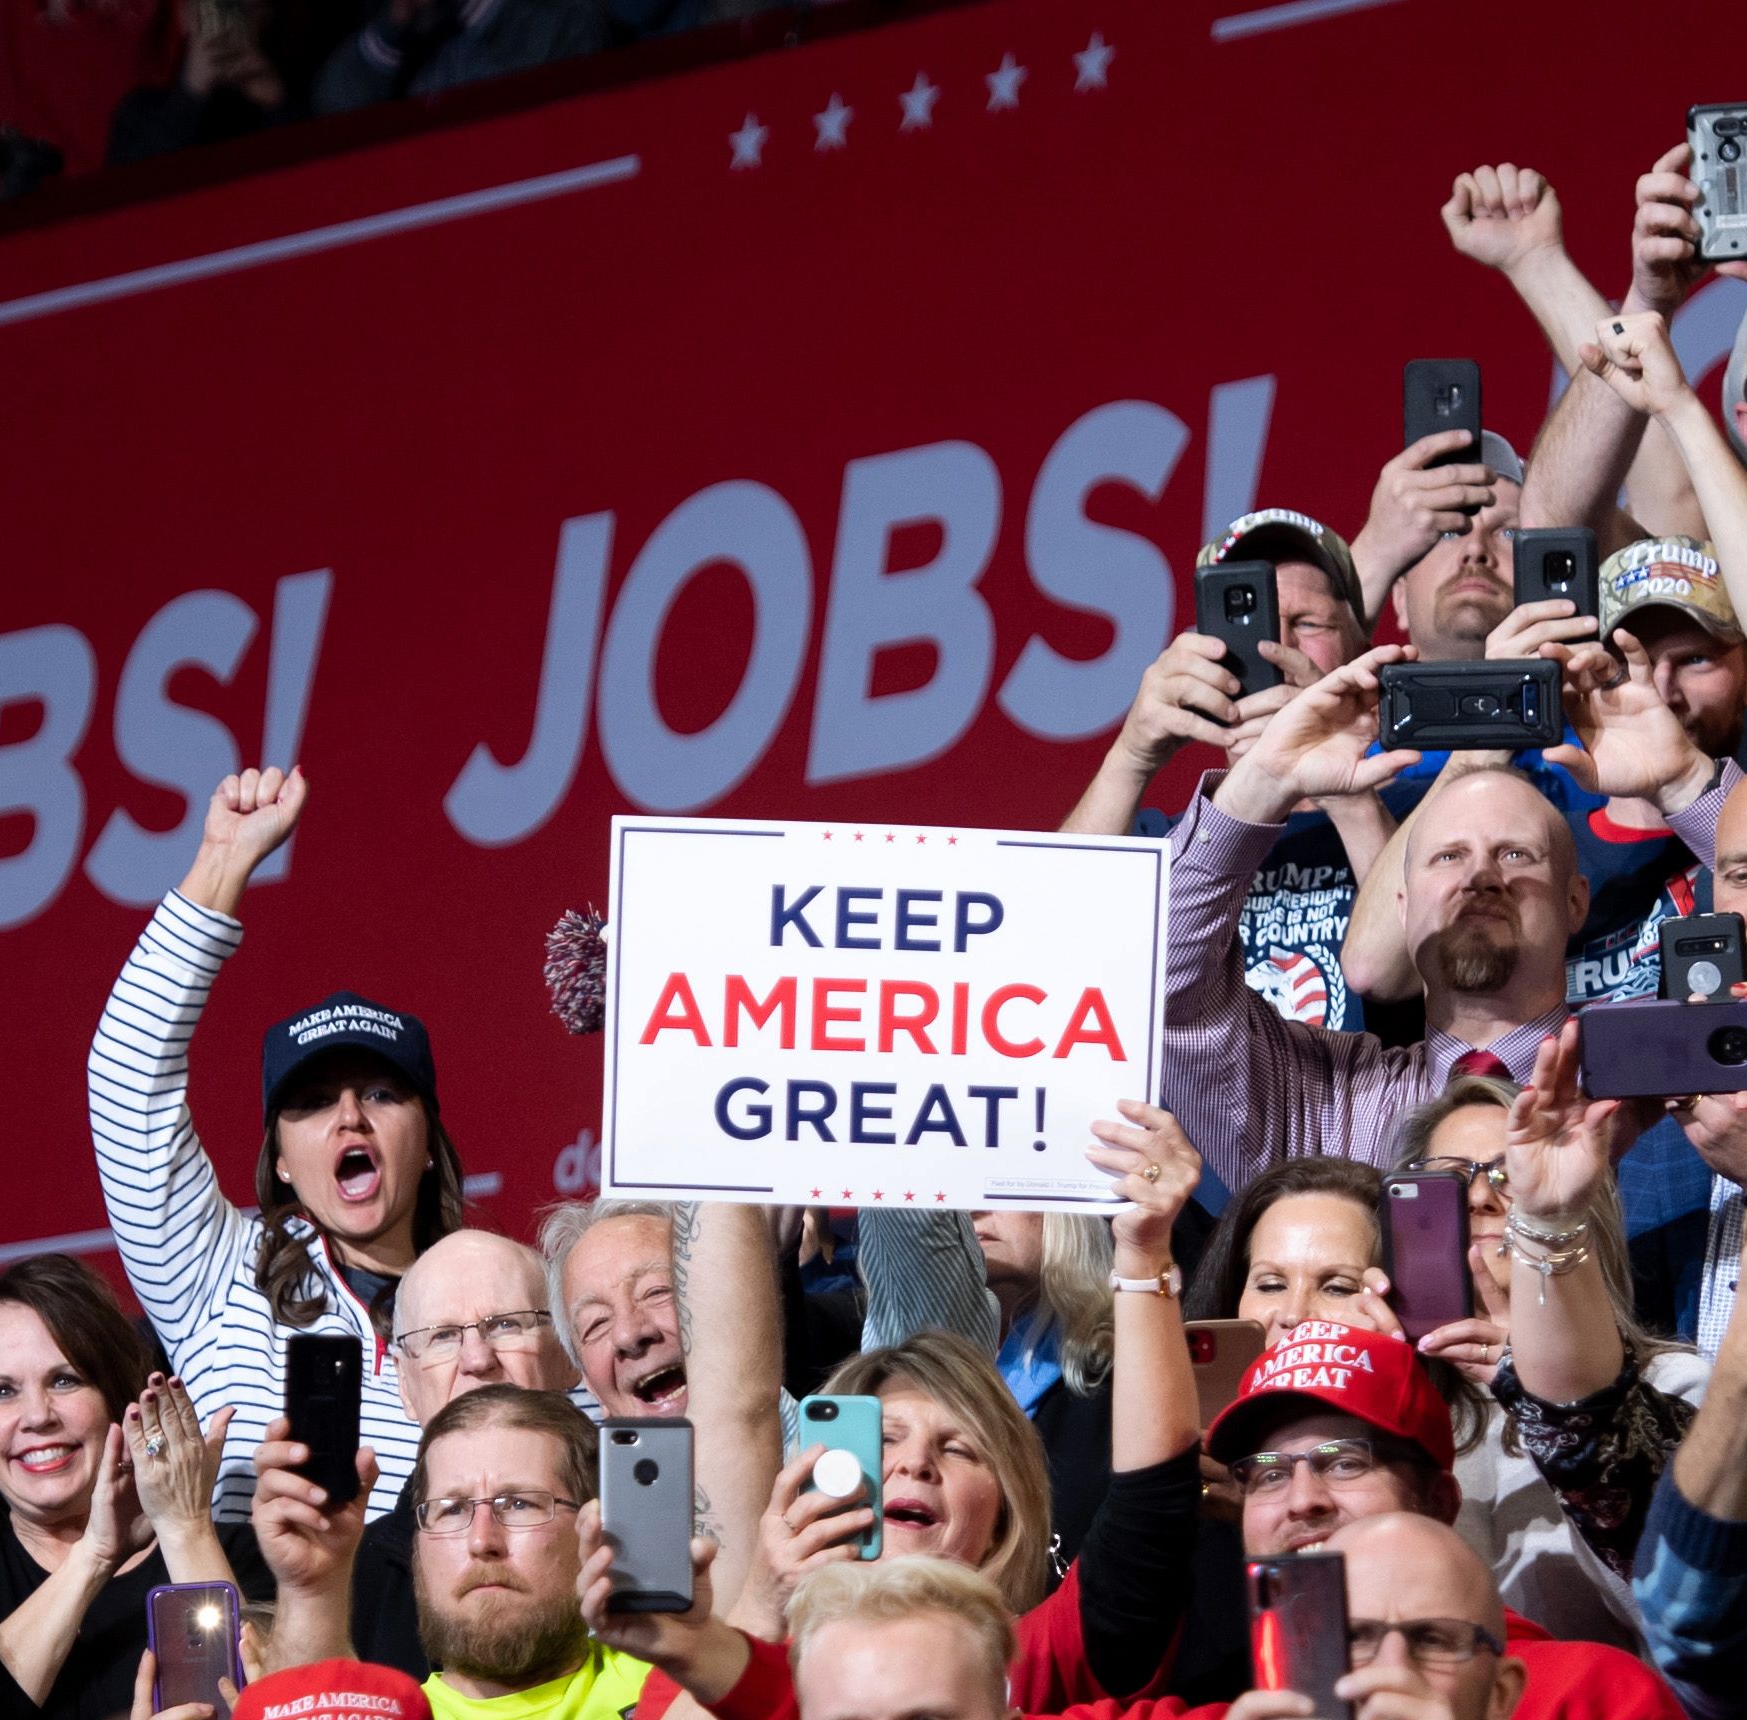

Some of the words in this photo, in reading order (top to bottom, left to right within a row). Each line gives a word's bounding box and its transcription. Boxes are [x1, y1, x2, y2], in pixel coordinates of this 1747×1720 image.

[1623, 542, 1718, 579] Trump
[1636, 577, 1692, 598] 2020
[1248, 862, 1333, 894] RUMP
[1273, 884, 1355, 909] PRESIDENT
[769, 883, 1005, 953] KEEP
[1255, 905, 1286, 929] THIS
[1287, 908, 1304, 926] IS
[1306, 900, 1339, 922] NOT
[1255, 915, 1350, 948] COUNTRY
[289, 1009, 332, 1037] MAKE
[333, 1005, 404, 1031] AMERICA
[297, 1019, 347, 1045] GREAT
[348, 1018, 397, 1041] AGAIN
[639, 971, 1128, 1062] AMERICA
[713, 1076, 1047, 1153] GREAT!
[1274, 1320, 1350, 1353] KEEP
[1250, 1343, 1374, 1393] AMERICA
[263, 1694, 314, 1720] MAKE
[315, 1692, 402, 1716] AMERICA
